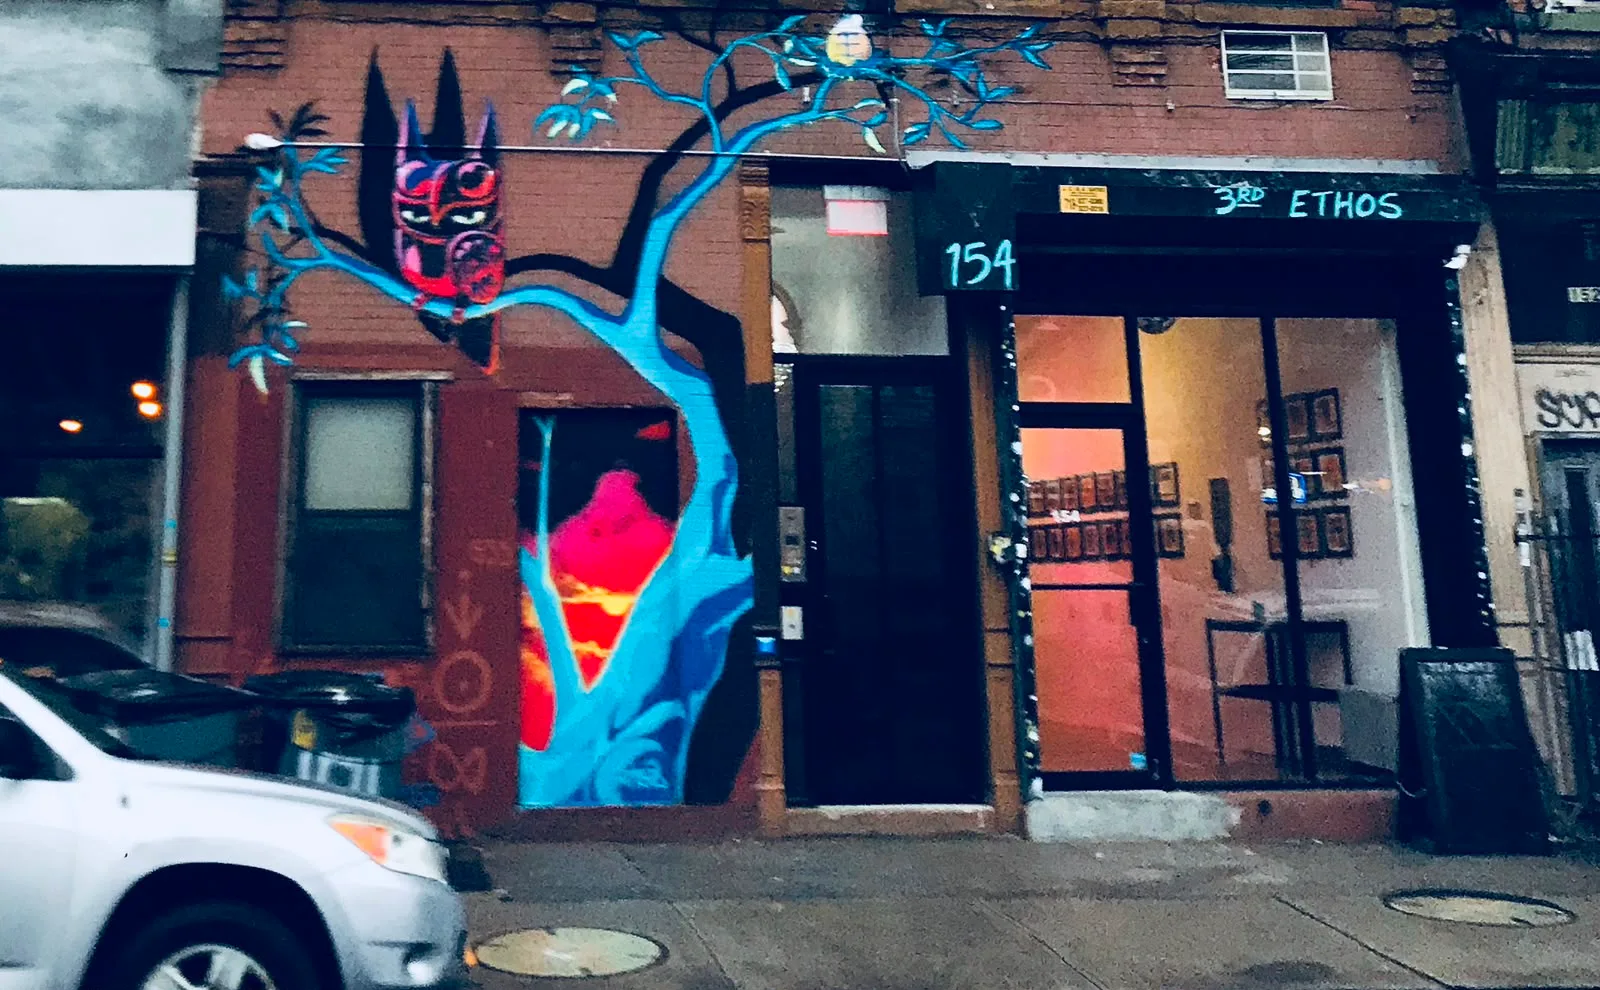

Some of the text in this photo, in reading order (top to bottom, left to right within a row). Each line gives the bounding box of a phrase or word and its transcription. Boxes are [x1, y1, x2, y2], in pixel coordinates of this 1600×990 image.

[1214, 187, 1402, 219] 3RD ETHOS
[945, 239, 1016, 289] 154
